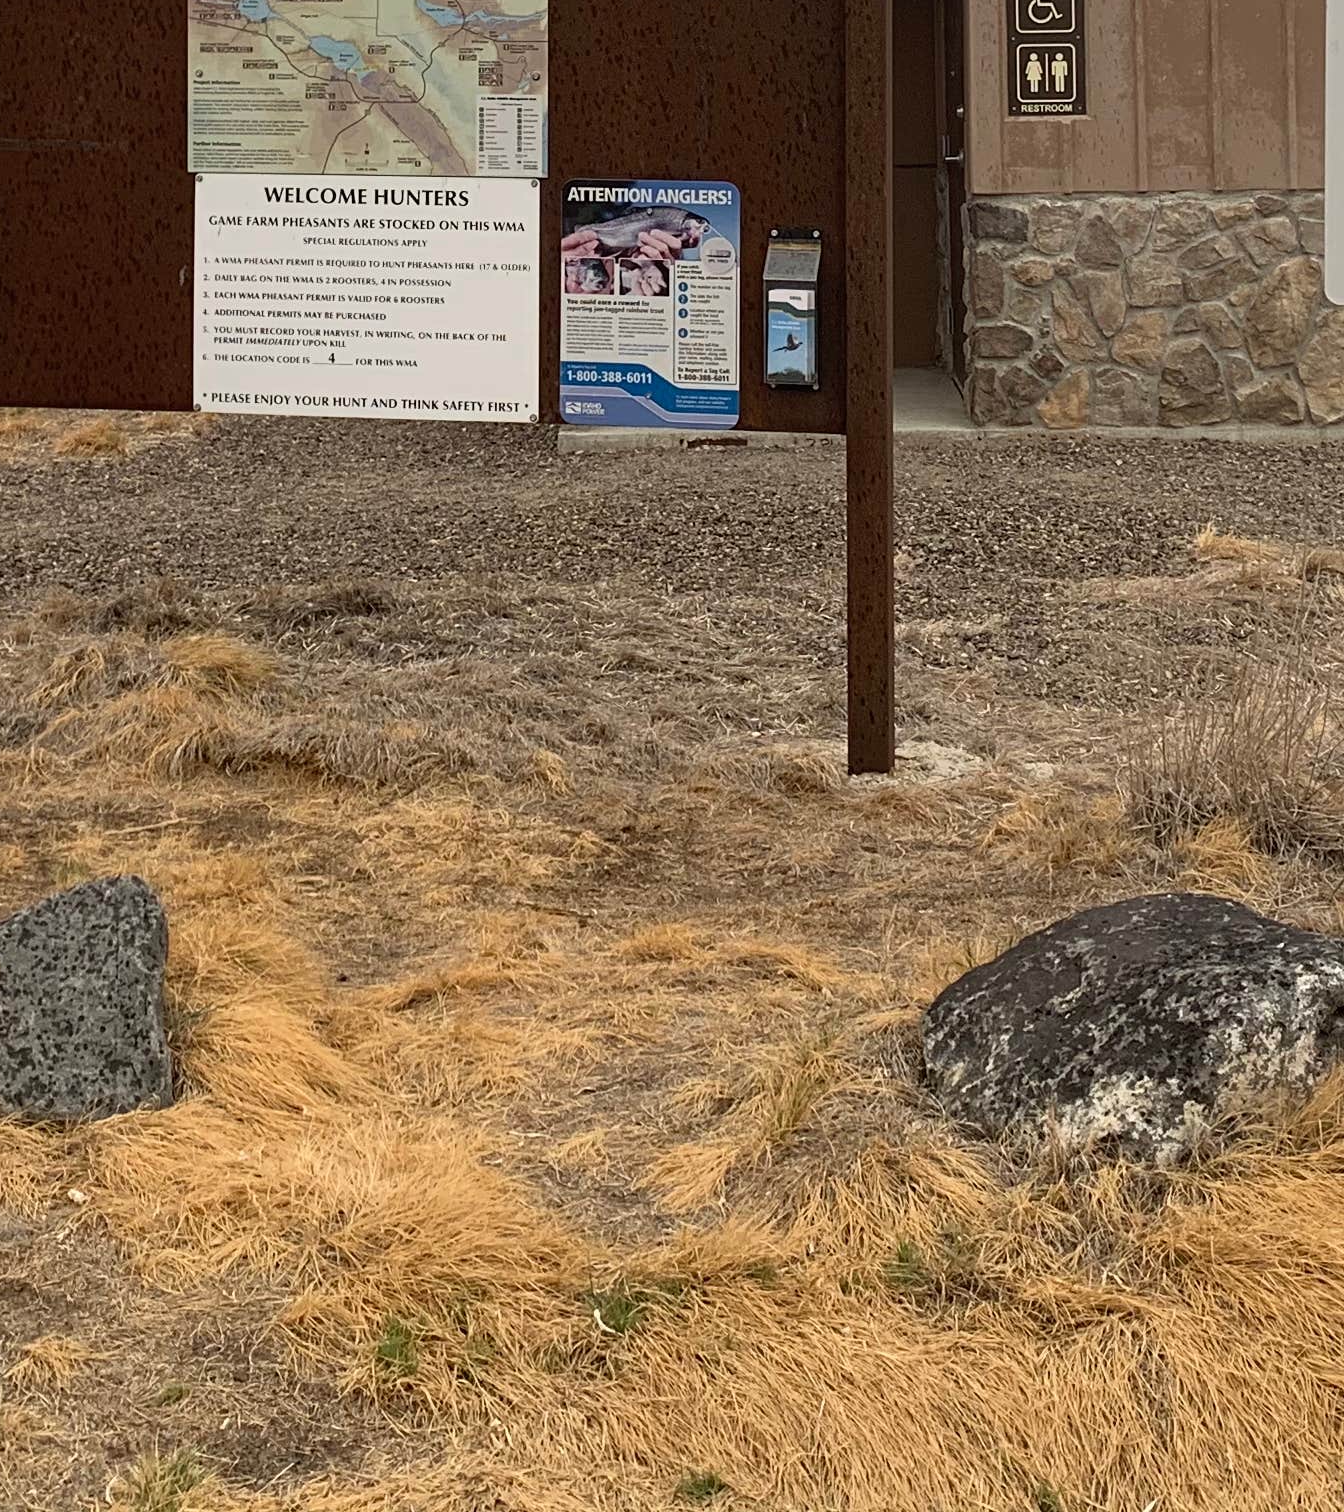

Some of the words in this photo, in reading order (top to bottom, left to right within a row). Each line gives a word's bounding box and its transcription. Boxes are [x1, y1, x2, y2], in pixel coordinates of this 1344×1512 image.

[1020, 103, 1073, 113] RESTROOM
[263, 186, 367, 204] WELCOME
[374, 188, 469, 207] HUNTERS
[567, 186, 652, 203] ATTENTION
[654, 188, 732, 205] ANGLERS!
[208, 215, 242, 226] GAME
[245, 215, 278, 227] FARM
[282, 216, 350, 228] PHEASANTS
[353, 218, 375, 229] ARE
[378, 218, 435, 230] STOCKED
[438, 220, 459, 230] ON
[462, 220, 490, 231] THIS
[492, 221, 525, 232] WMA
[302, 236, 336, 245] SPECIAL
[338, 237, 399, 246] REGULATIONS
[401, 239, 426, 247] APPLY
[213, 291, 237, 299] EACH
[237, 291, 260, 299] WMA
[261, 292, 304, 300] PHEASANT
[305, 293, 336, 302] PERMIT
[347, 294, 372, 303] VALID
[373, 295, 391, 303] FOR
[400, 296, 445, 305] ROOSTERS
[214, 308, 265, 317] ADDITIONAL
[266, 309, 302, 318] PERMITS
[303, 311, 321, 319] MAY
[335, 312, 387, 321] PURCHASED
[327, 352, 335, 364] 4
[566, 370, 652, 384] 1-800-388-6011
[677, 373, 729, 382] 1-800-388-6011
[211, 392, 250, 404] PLEASE
[254, 393, 291, 405] ENJOY
[294, 395, 329, 406] YOUR
[332, 396, 367, 407] HUNT
[370, 397, 398, 408] AND
[400, 398, 439, 410] THINK
[442, 399, 482, 411] SAFETY
[487, 401, 520, 412] FIRST
